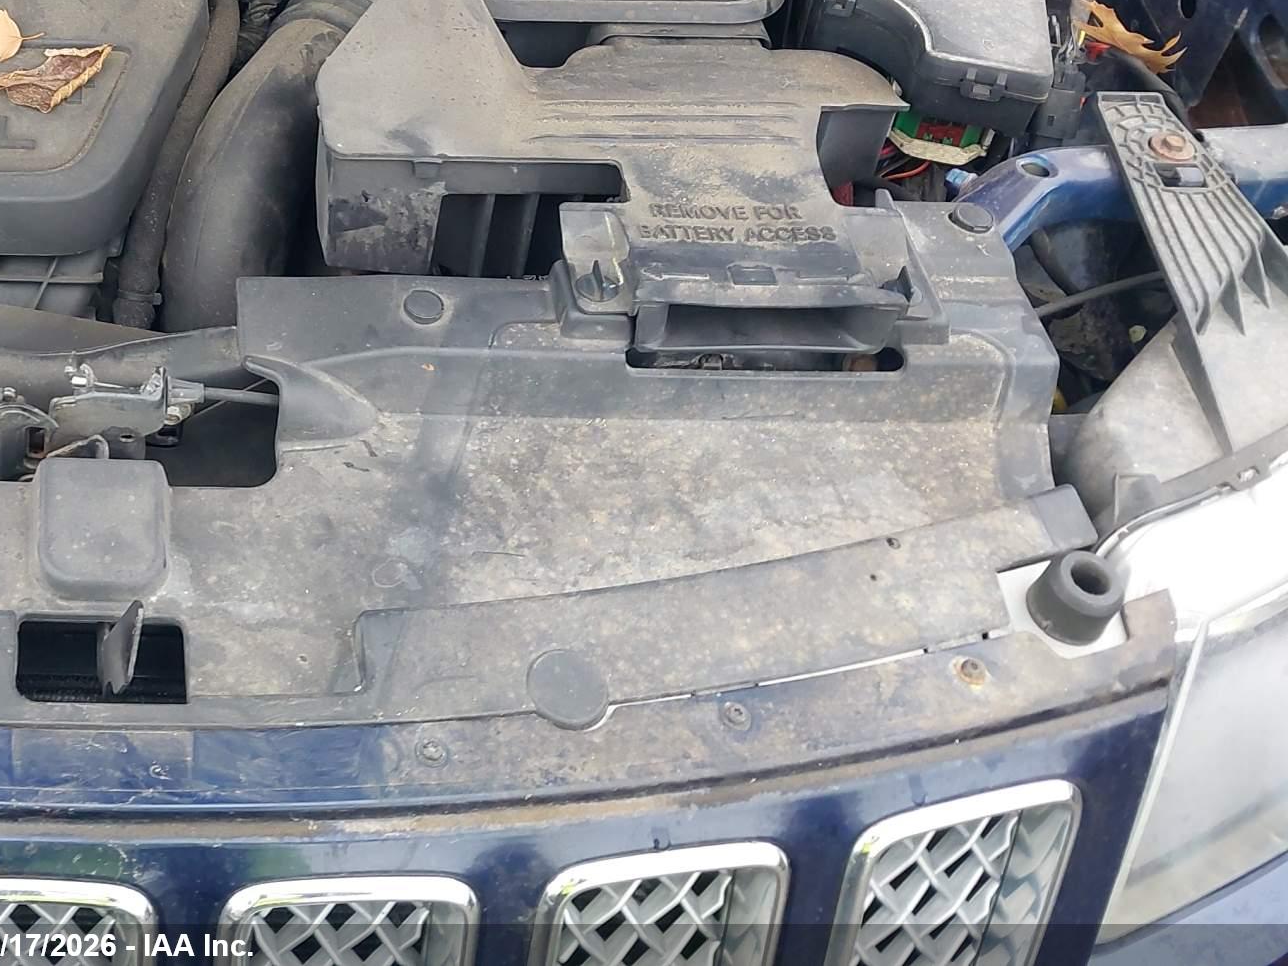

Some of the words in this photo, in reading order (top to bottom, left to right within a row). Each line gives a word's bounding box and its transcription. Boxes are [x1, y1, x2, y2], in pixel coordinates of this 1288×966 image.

[649, 203, 749, 221] REMOVE
[754, 204, 803, 221] FOR
[639, 224, 736, 242] BATTERY
[744, 226, 837, 243] ACCESS
